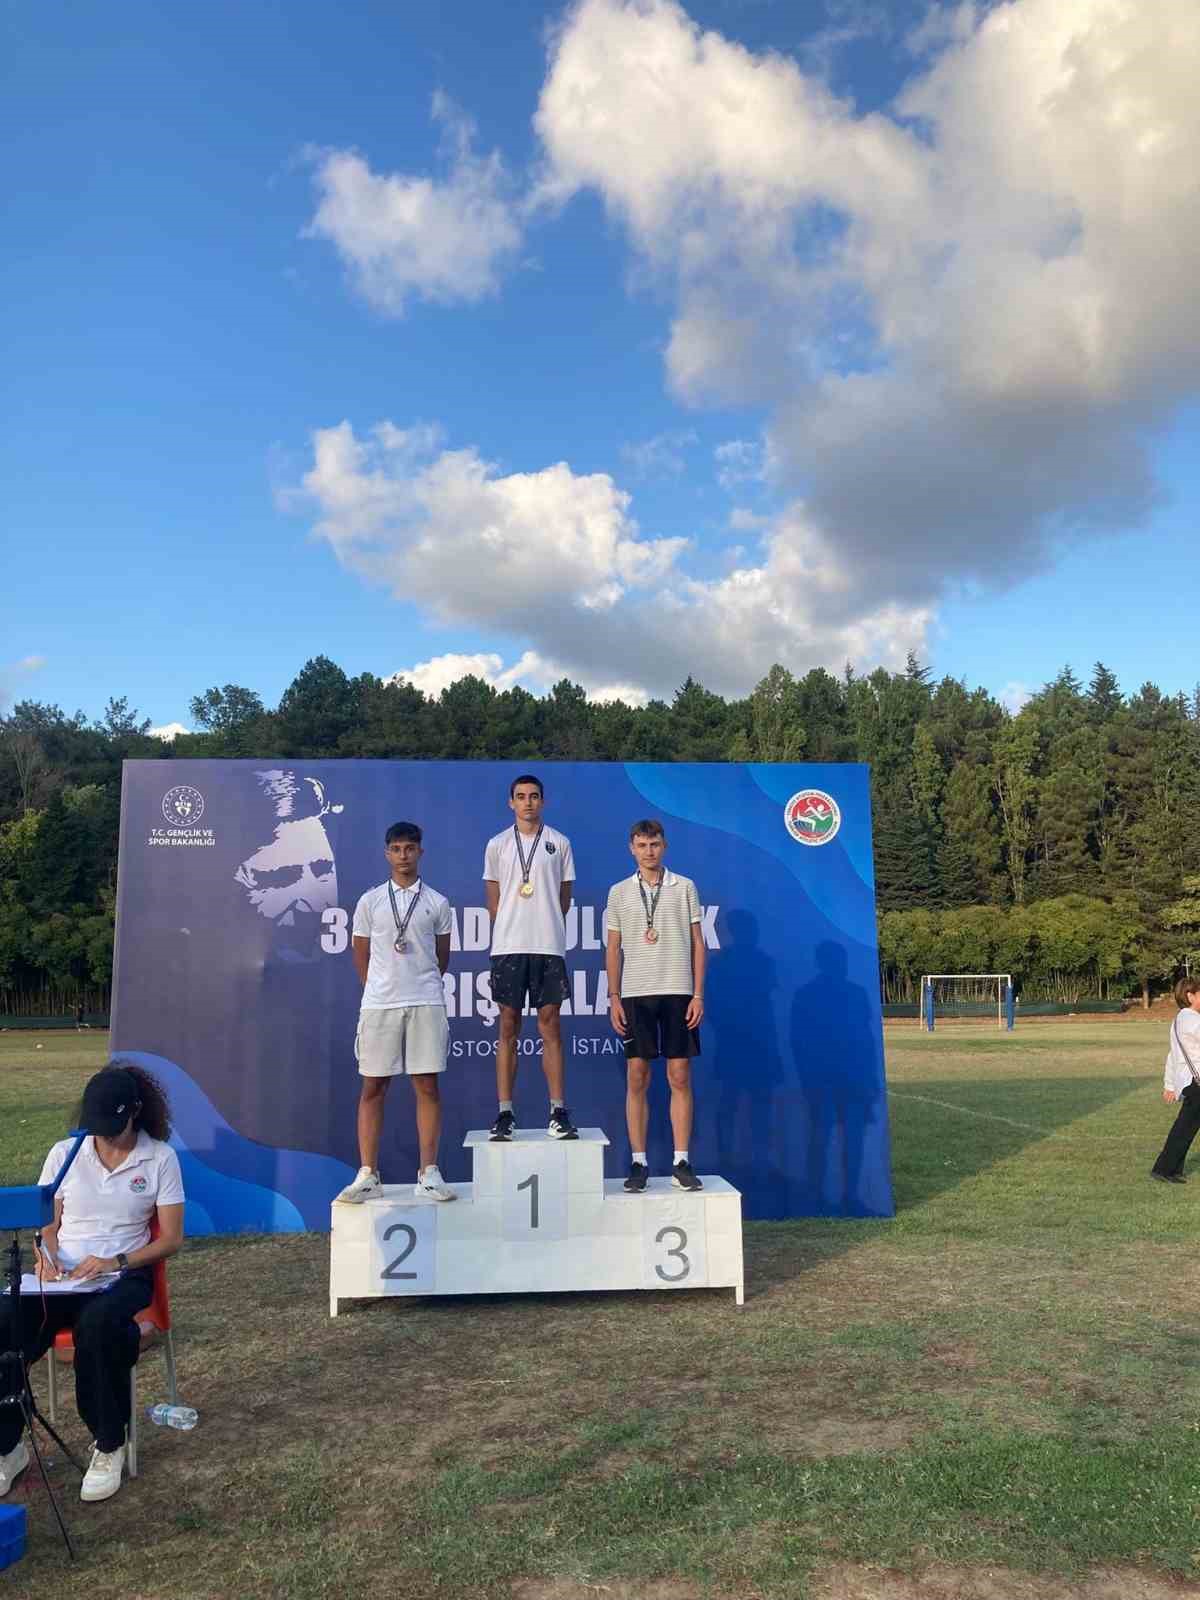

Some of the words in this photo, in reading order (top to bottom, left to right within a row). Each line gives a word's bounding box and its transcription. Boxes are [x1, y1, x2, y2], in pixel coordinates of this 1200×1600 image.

[148, 838, 170, 846] SPOR
[172, 837, 216, 846] BAKANLIĞI
[151, 829, 165, 837] T.C.
[167, 828, 202, 838] GENÇLİK
[203, 829, 214, 837] VE
[572, 1034, 625, 1055] İSTAN
[517, 1173, 539, 1229] 1
[381, 1223, 418, 1280] 2
[655, 1226, 691, 1282] 3
